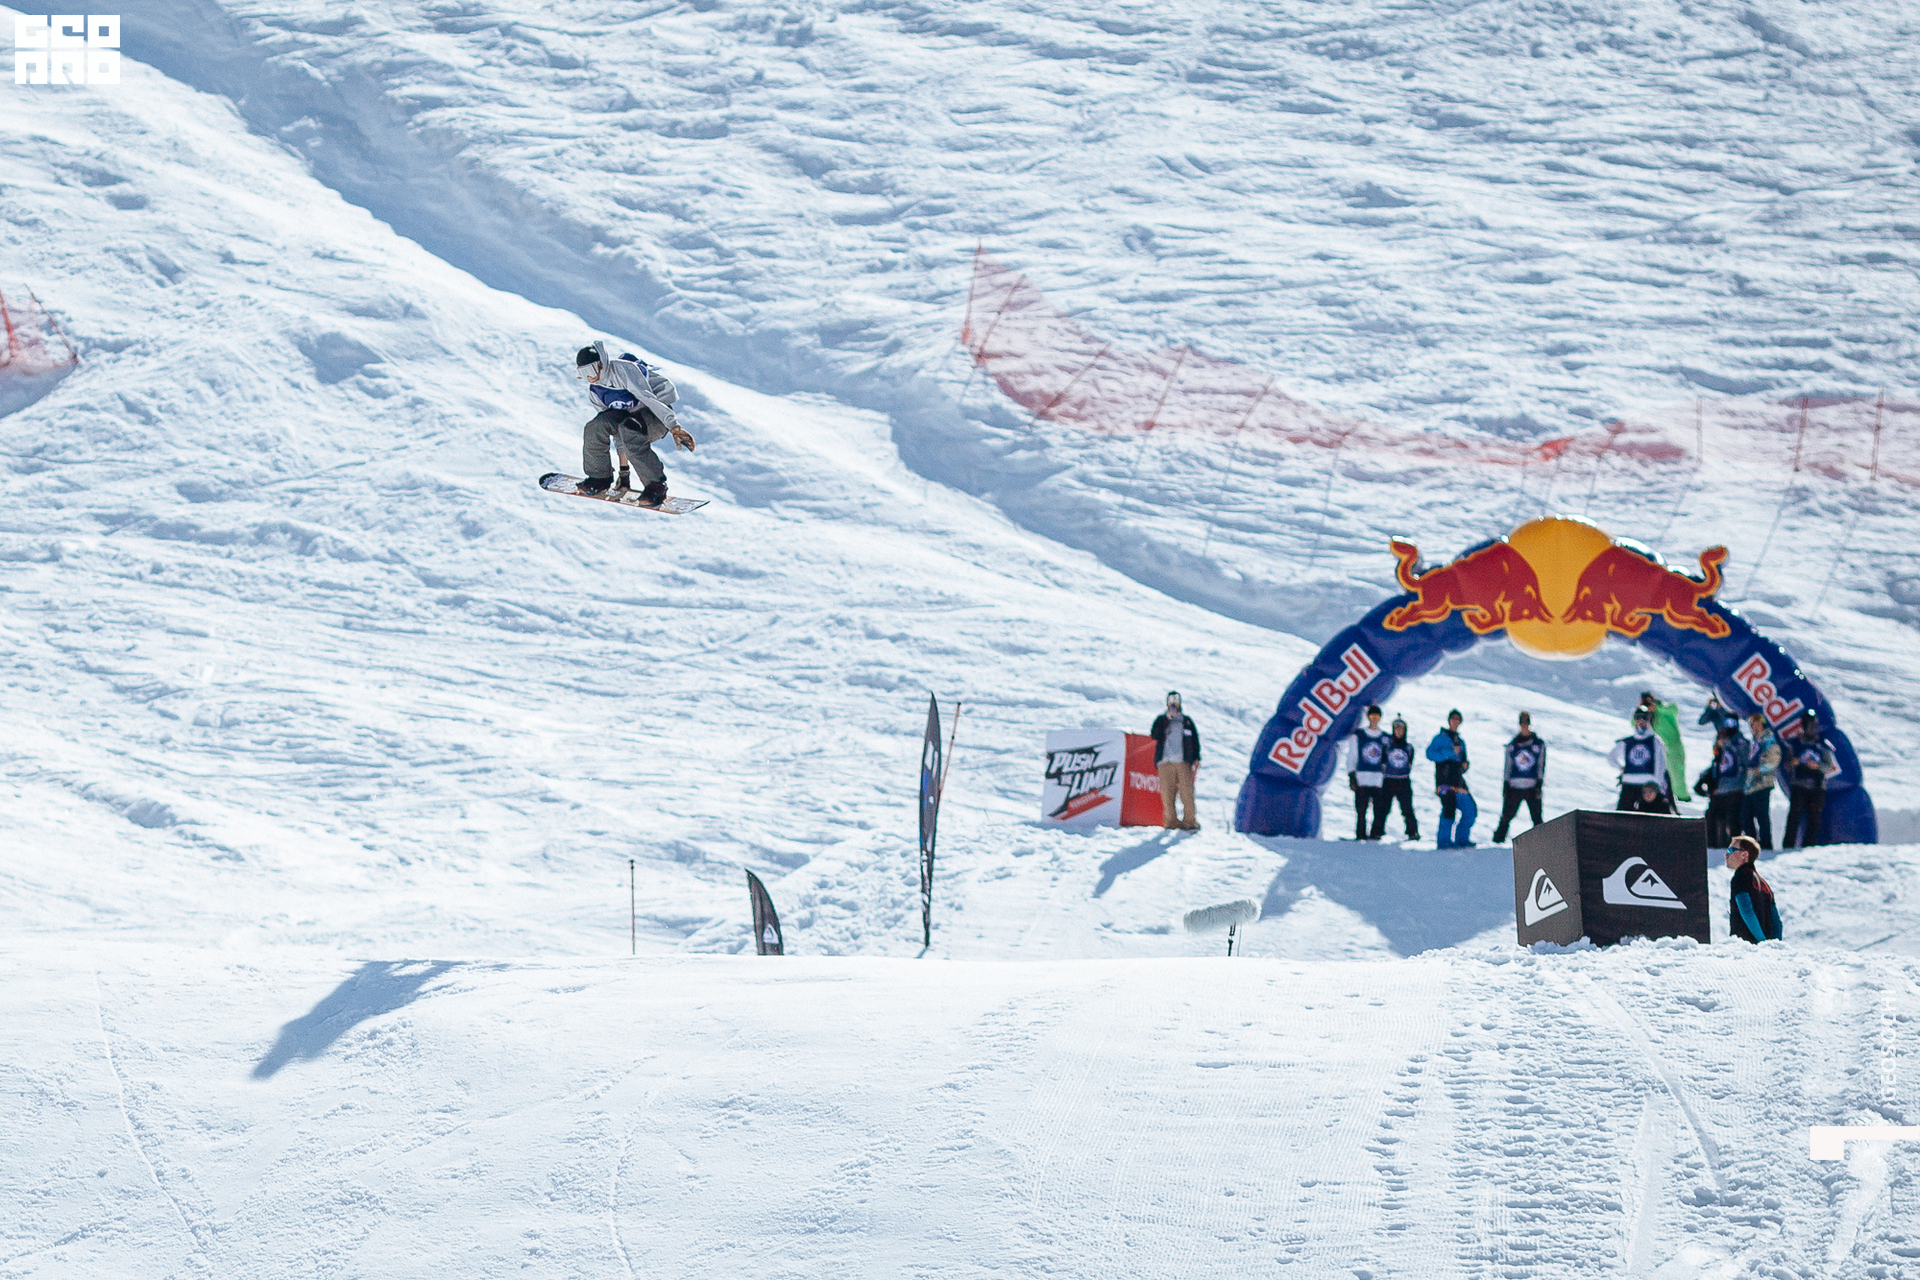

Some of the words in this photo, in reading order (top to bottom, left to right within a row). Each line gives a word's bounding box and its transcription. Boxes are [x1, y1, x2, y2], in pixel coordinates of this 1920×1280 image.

[1270, 699, 1331, 773] Red
[1312, 646, 1377, 713] Bull
[1734, 654, 1802, 726] Red
[1048, 752, 1096, 774] PUSH
[1069, 767, 1115, 798] LIMIT
